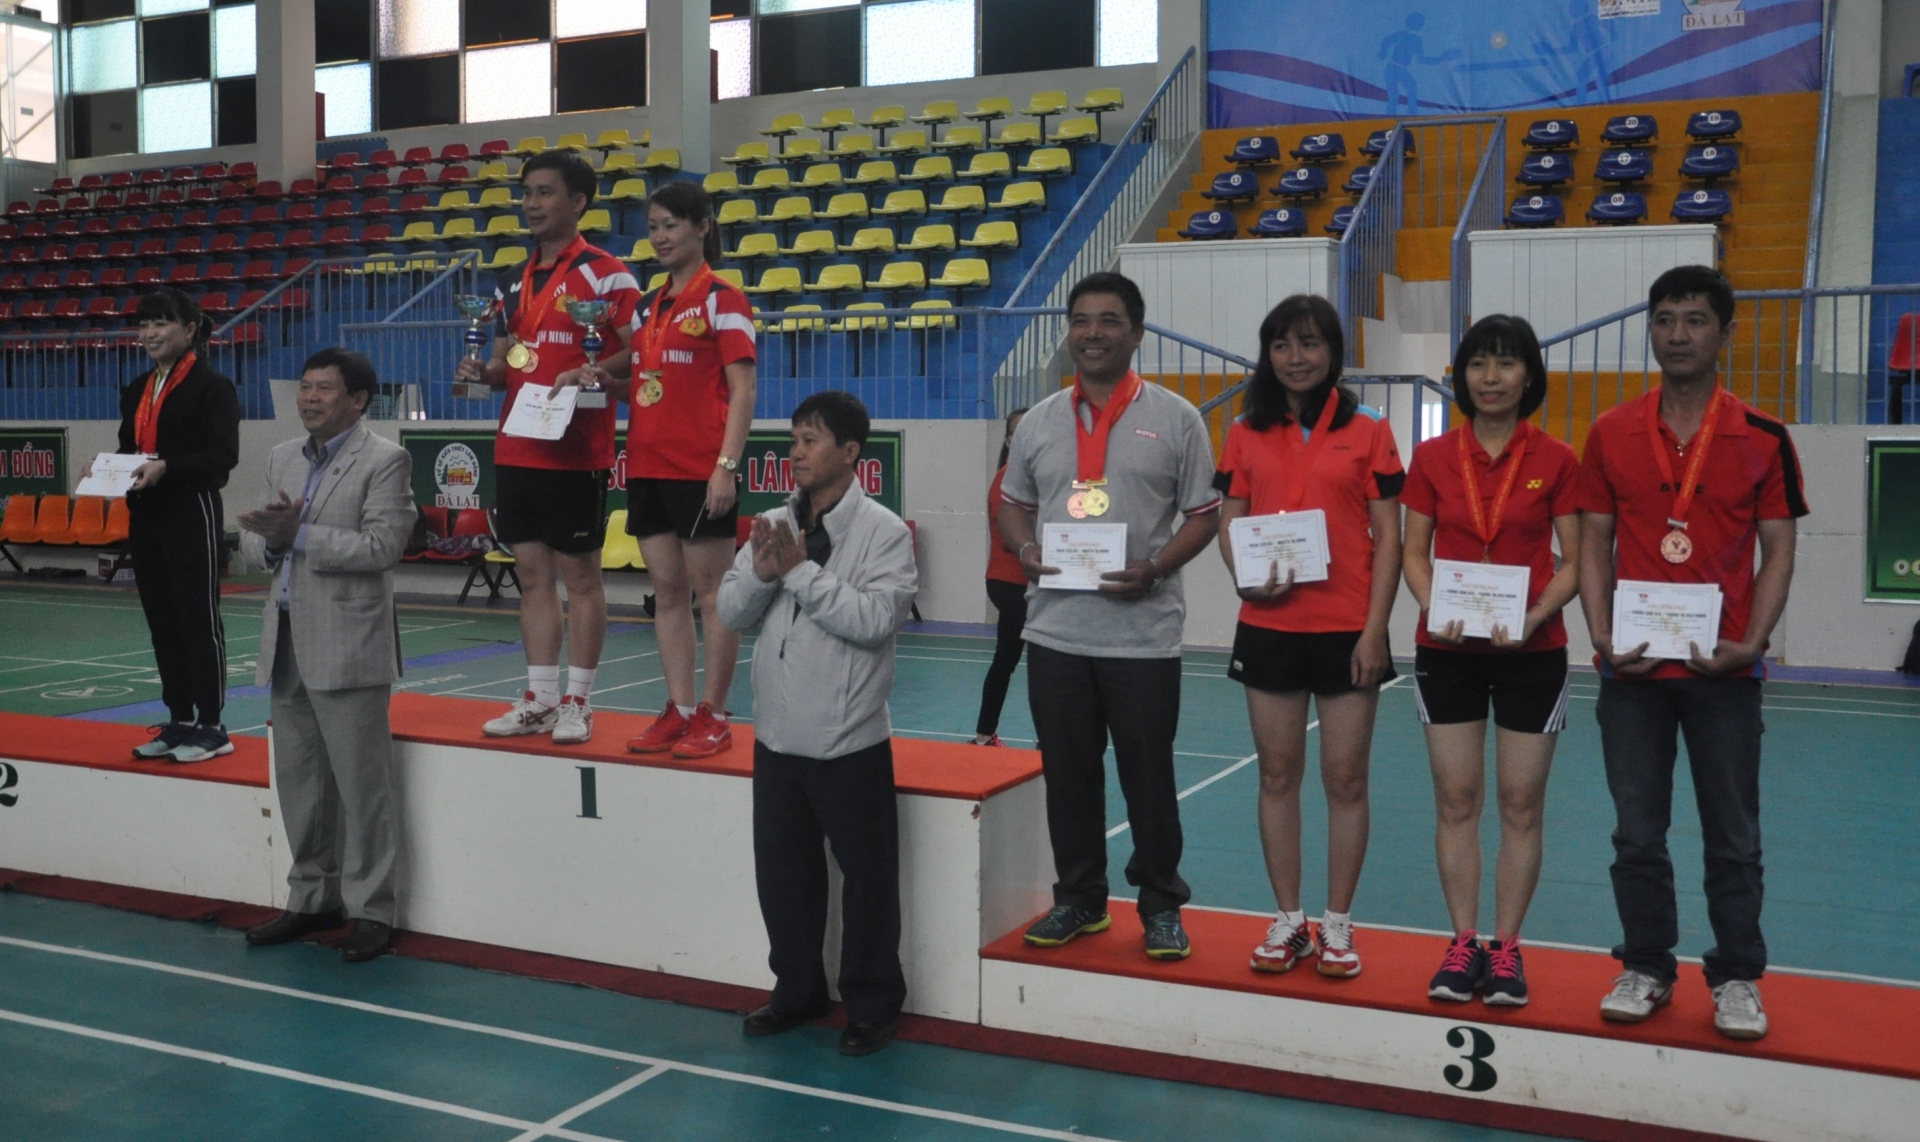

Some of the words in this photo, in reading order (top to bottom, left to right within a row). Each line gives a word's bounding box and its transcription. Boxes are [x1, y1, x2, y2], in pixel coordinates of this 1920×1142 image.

[1686, 13, 1706, 28] ĐÀ
[1712, 12, 1744, 27] LẠT
[548, 330, 573, 345] NINH
[668, 349, 694, 364] NINH
[12, 441, 55, 478] ĐỒNG
[437, 492, 453, 507] ĐÀ
[456, 495, 479, 509] LẠT
[575, 765, 603, 820] 1
[1443, 1025, 1498, 1093] 3
